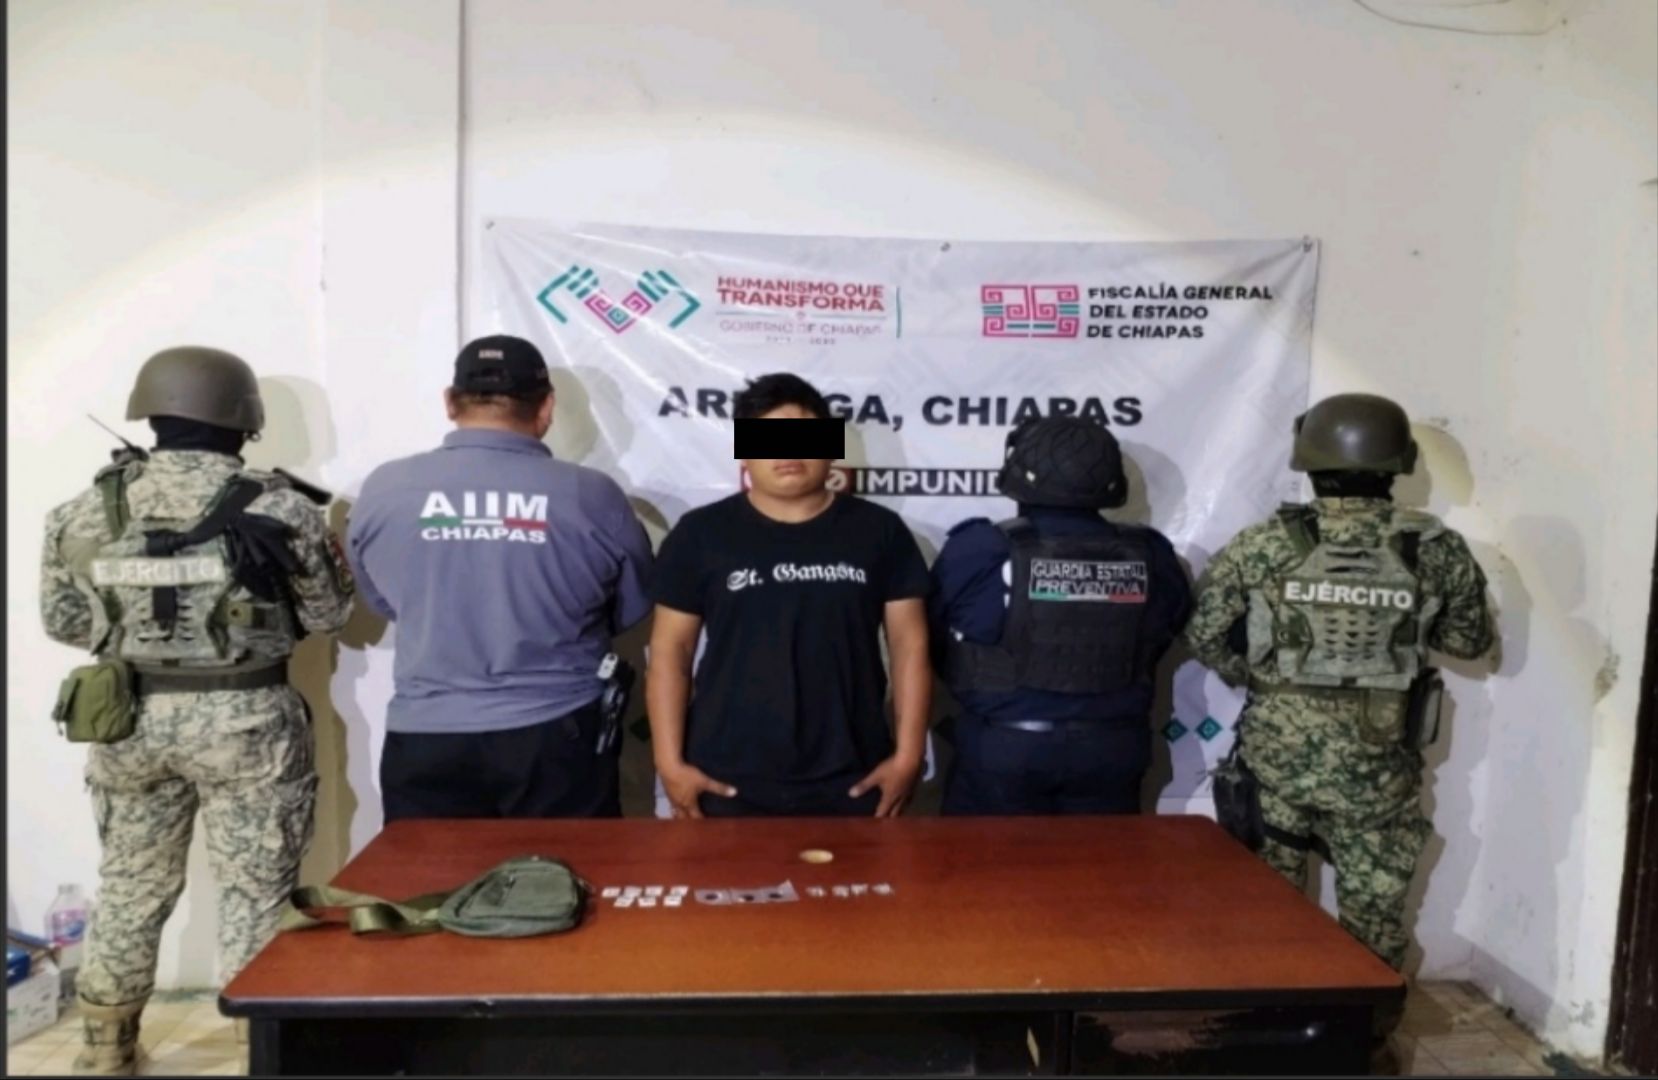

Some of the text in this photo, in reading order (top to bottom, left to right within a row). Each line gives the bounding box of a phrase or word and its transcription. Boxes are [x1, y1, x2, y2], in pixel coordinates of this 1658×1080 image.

[717, 276, 885, 298] HUMANISMO QUE
[1088, 282, 1273, 300] FISCALÍA GENERAL
[717, 289, 885, 311] TRANSFORMA
[1090, 304, 1208, 319] DEL ESTADO
[1087, 325, 1204, 339] DE CHIAPAS
[658, 386, 1143, 431] ARGA, CHIAPAS
[420, 491, 548, 521] AIIM
[421, 526, 547, 544] CHIAPAS
[1033, 561, 1146, 580] GUARDIA ESTATAL
[1036, 579, 1141, 595] PREVENTIVA
[1285, 580, 1413, 609] EJÉRCITO
